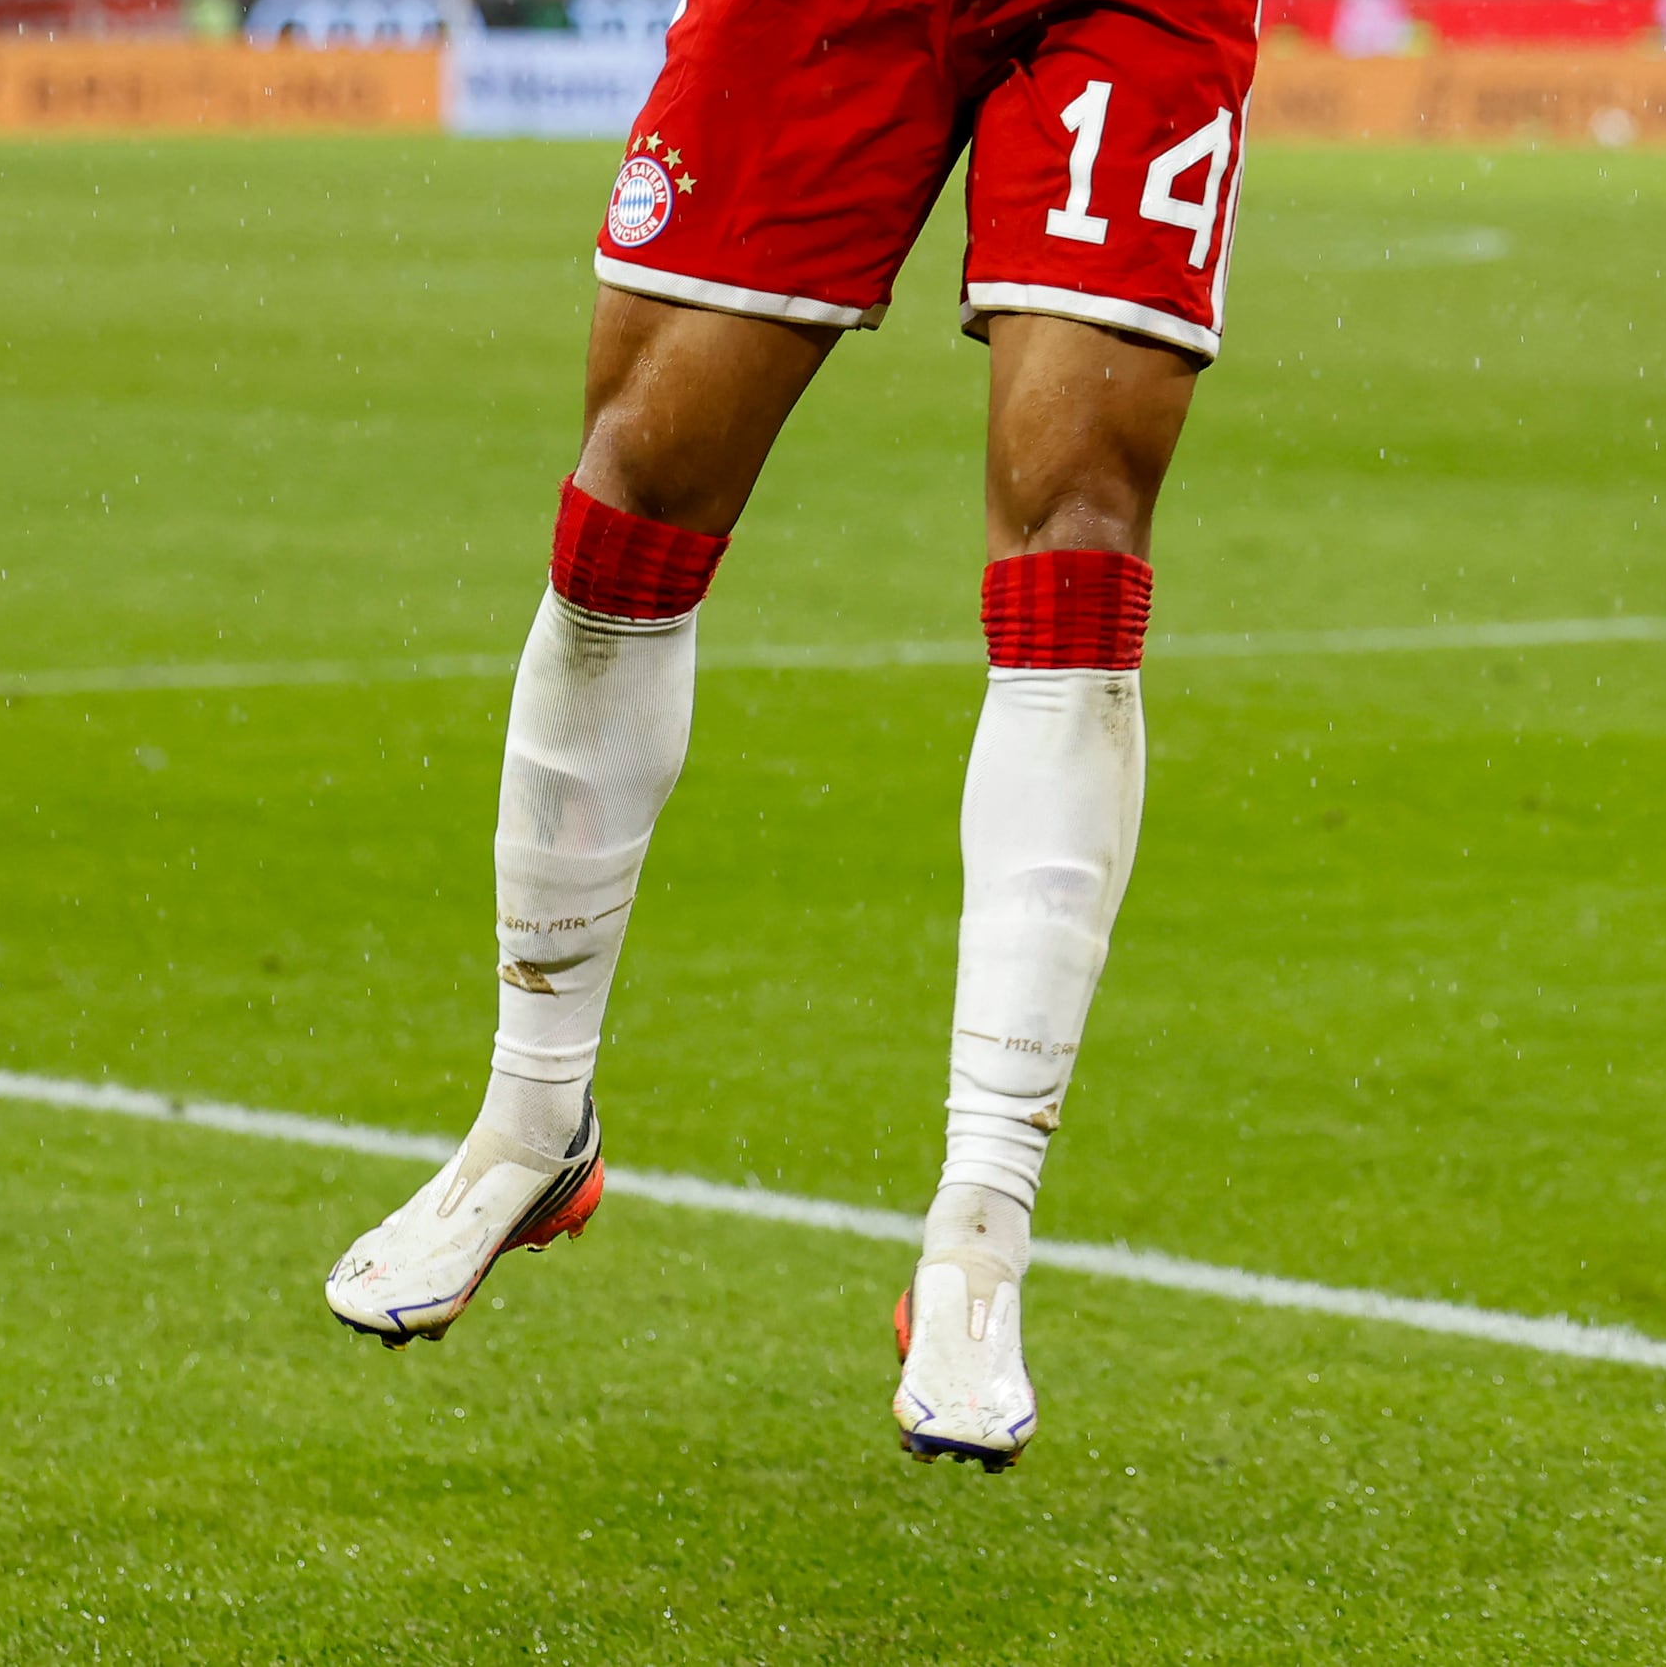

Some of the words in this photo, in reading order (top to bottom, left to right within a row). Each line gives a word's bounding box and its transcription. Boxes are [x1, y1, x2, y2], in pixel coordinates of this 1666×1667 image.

[617, 170, 631, 192] FC
[631, 163, 667, 204] BAYERN
[1045, 80, 1233, 270] 14
[1005, 1036, 1042, 1054] MIA
